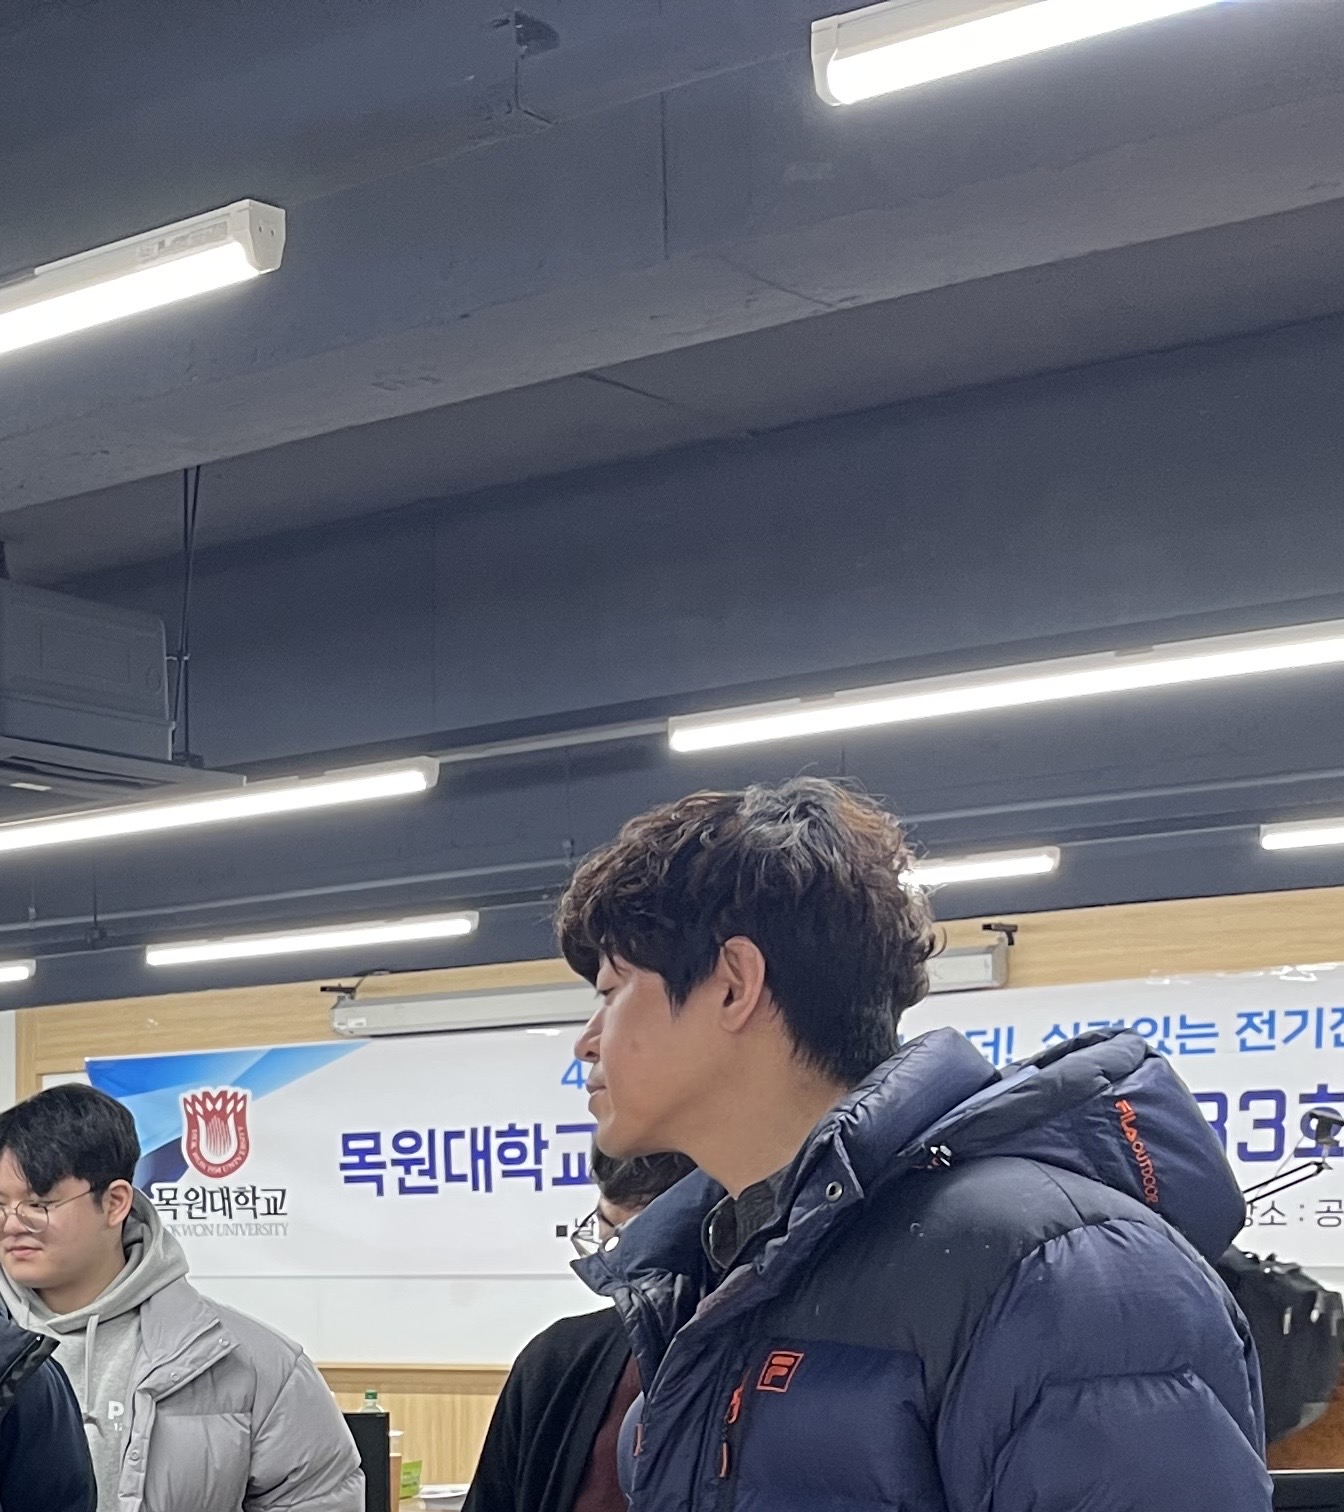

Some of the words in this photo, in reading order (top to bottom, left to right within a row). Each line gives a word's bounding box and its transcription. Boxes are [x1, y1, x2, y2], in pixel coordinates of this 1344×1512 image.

[339, 1123, 598, 1197] 목원대학교
[154, 1185, 288, 1220] 목원대학교
[216, 1222, 289, 1237] UNIVERSITY
